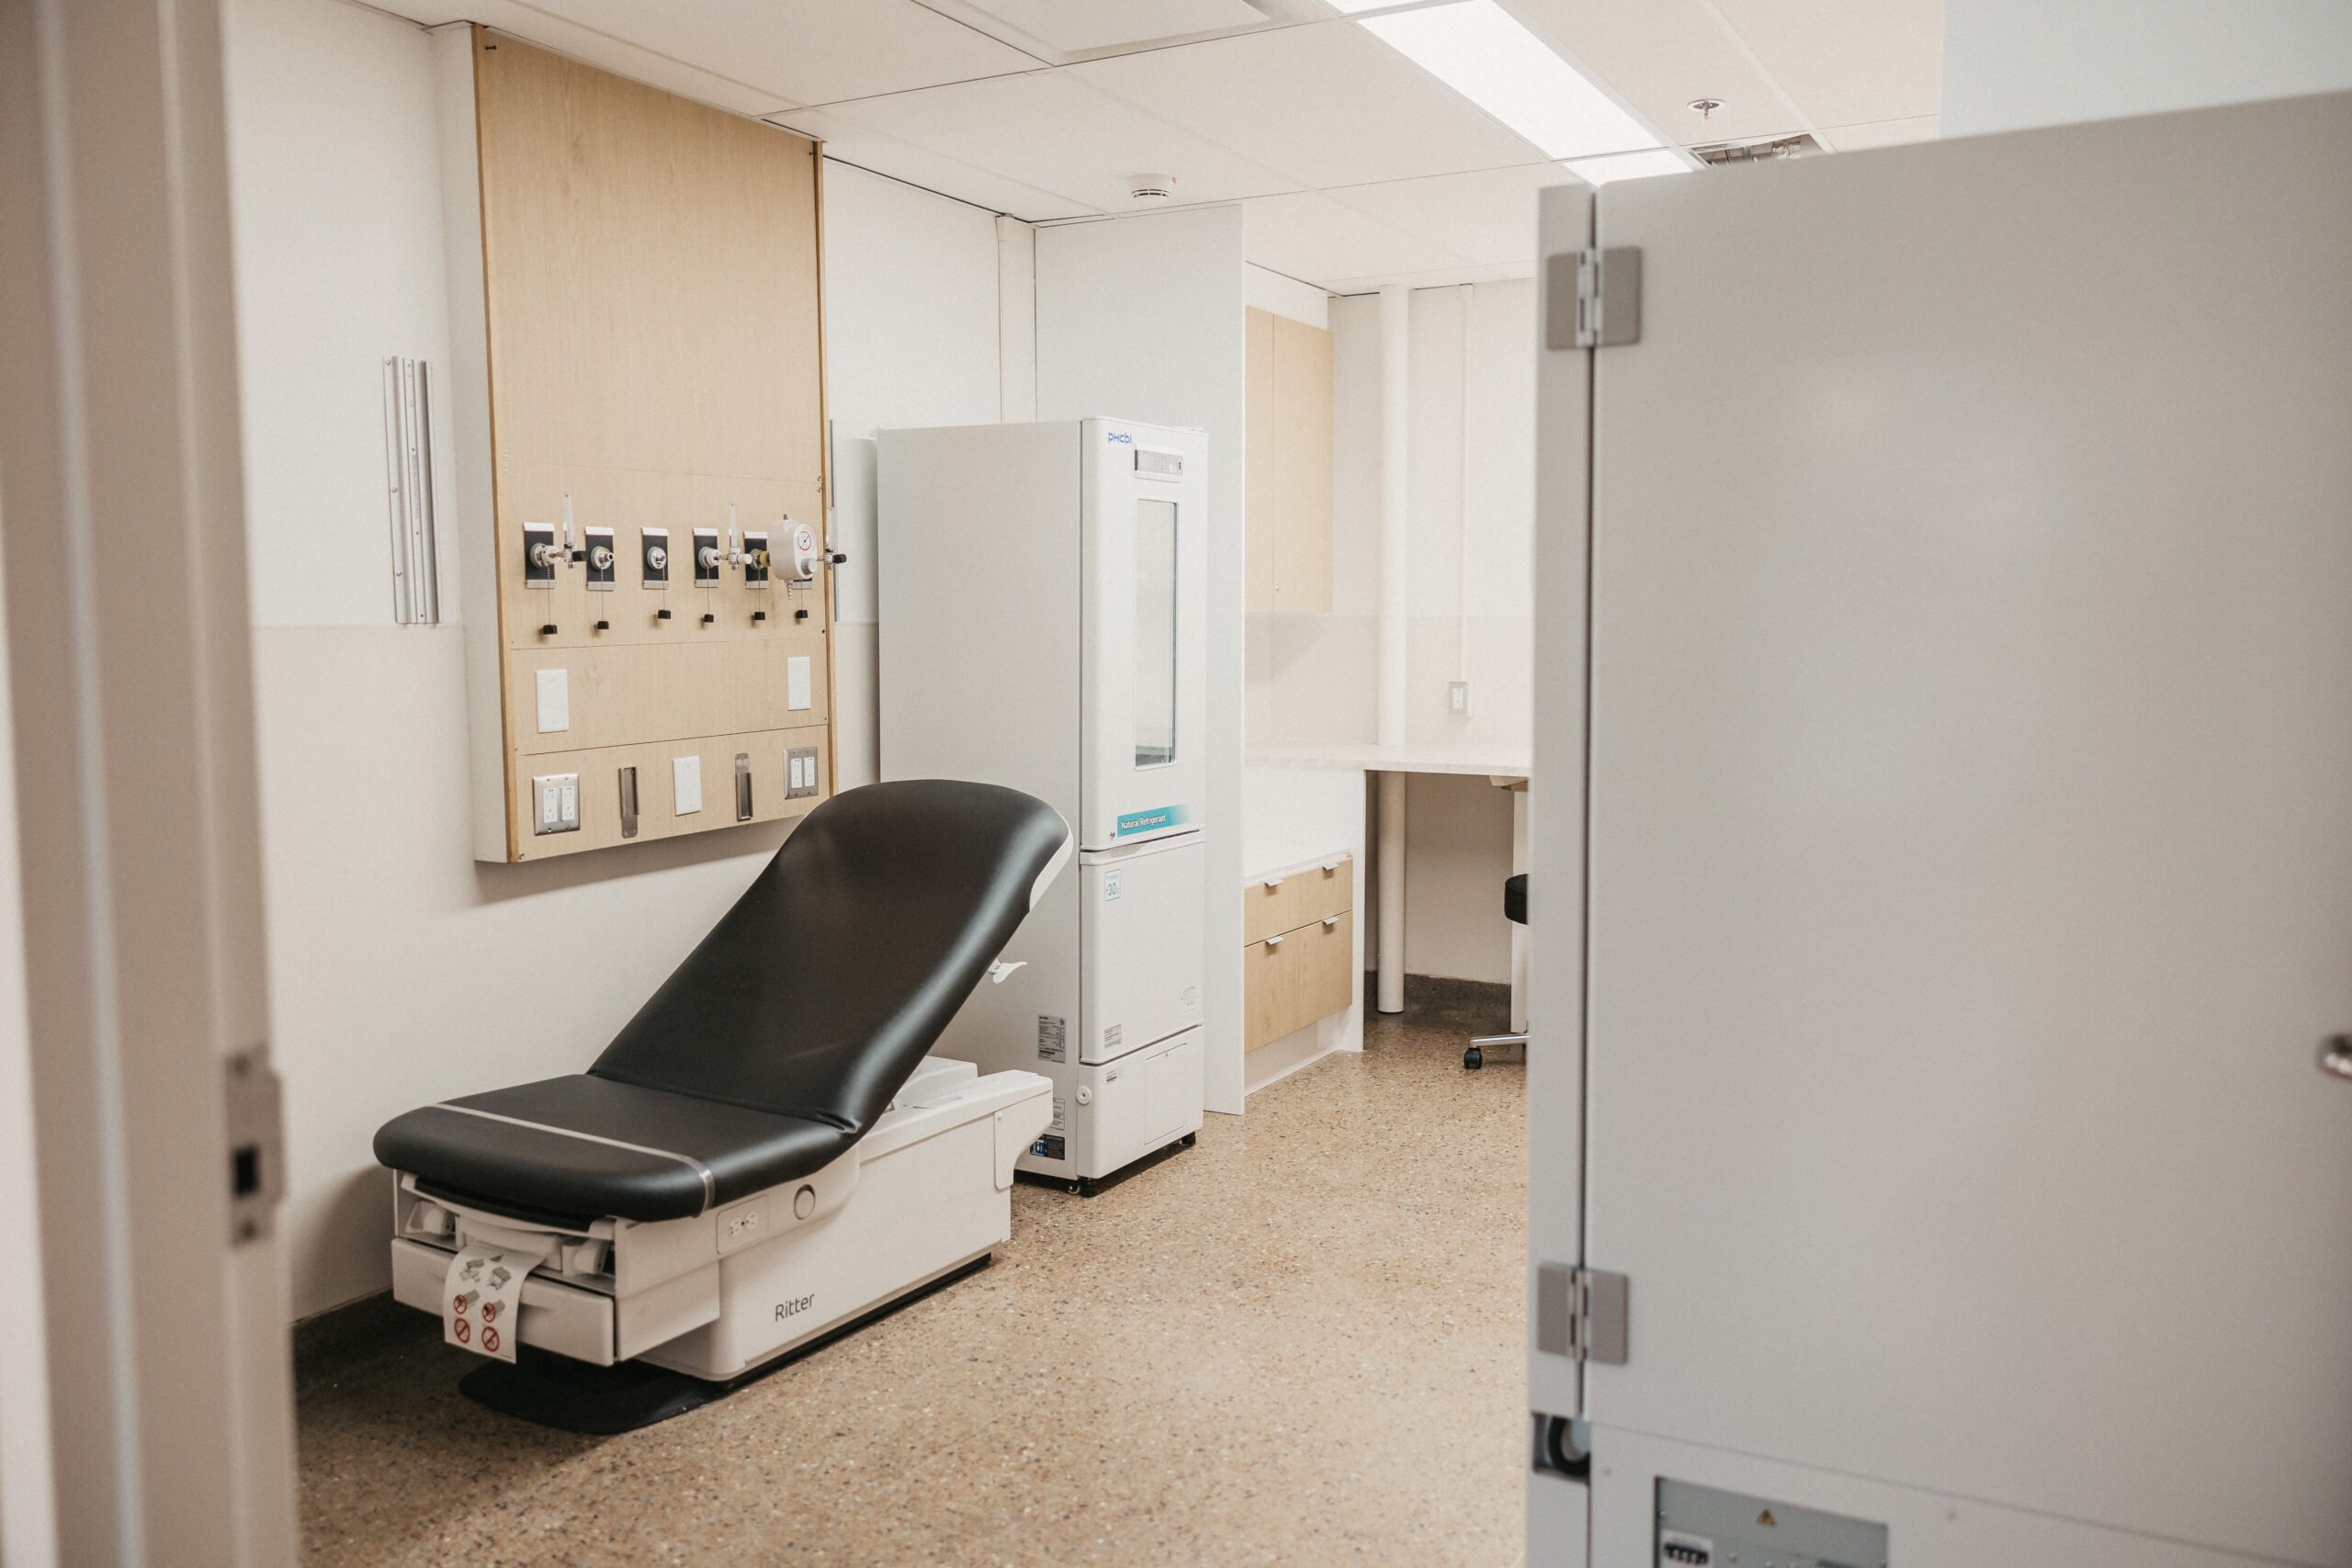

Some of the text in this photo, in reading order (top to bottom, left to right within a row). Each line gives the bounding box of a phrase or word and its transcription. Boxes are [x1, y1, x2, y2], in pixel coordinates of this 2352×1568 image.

[1122, 815, 1166, 830] Natural Refrigerant
[775, 1293, 815, 1322] Ritter
